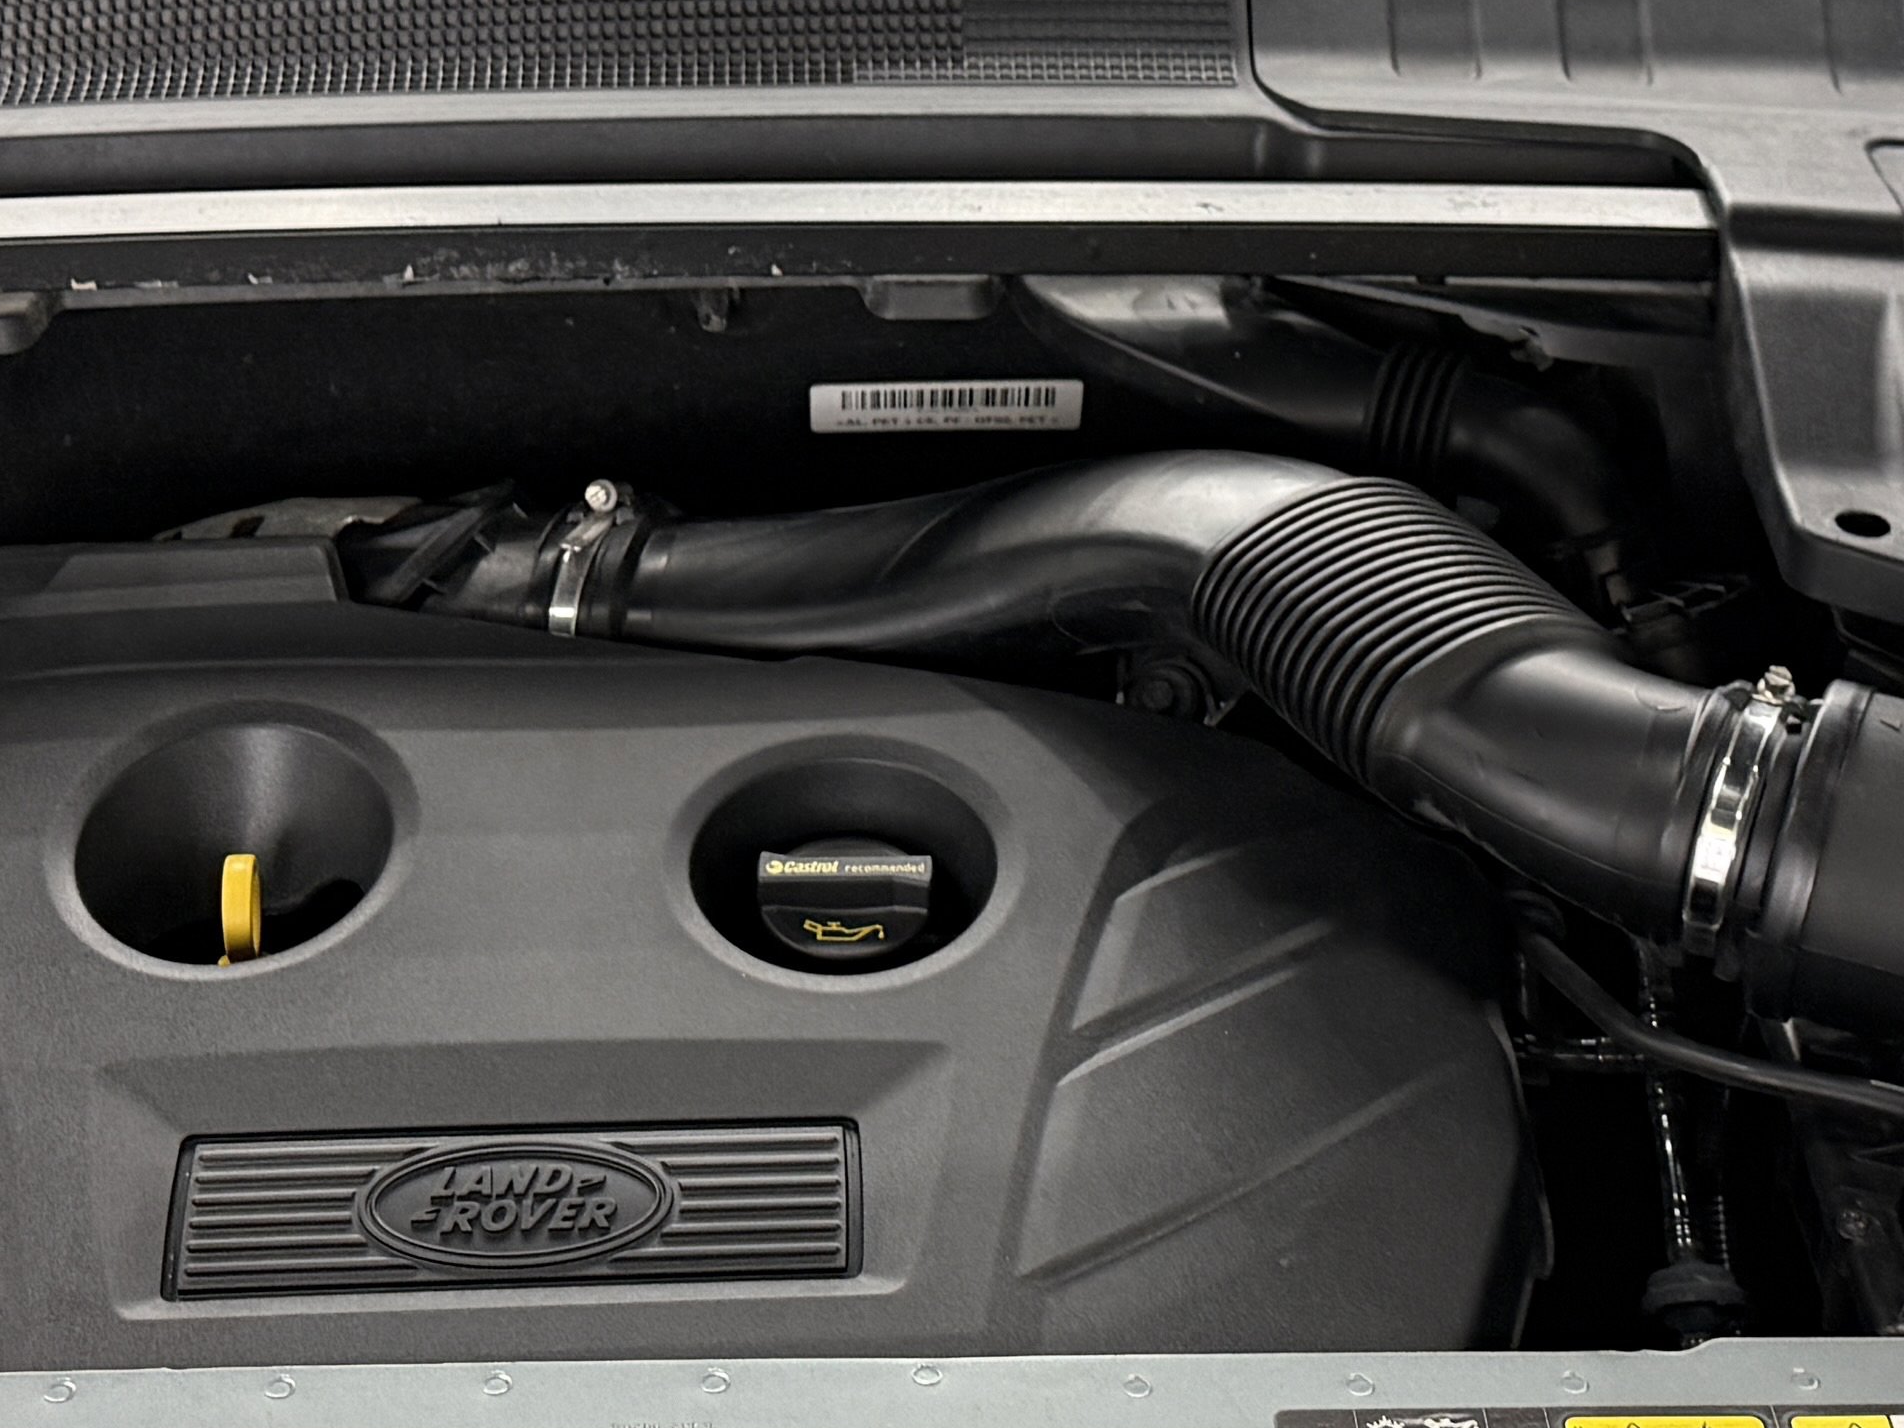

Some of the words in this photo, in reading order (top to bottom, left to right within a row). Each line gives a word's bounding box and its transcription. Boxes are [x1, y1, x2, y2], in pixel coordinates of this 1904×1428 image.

[784, 860, 839, 874] Castrol
[844, 862, 925, 874] recommended
[431, 1163, 574, 1200] LAND
[440, 1197, 618, 1234] ROVER
